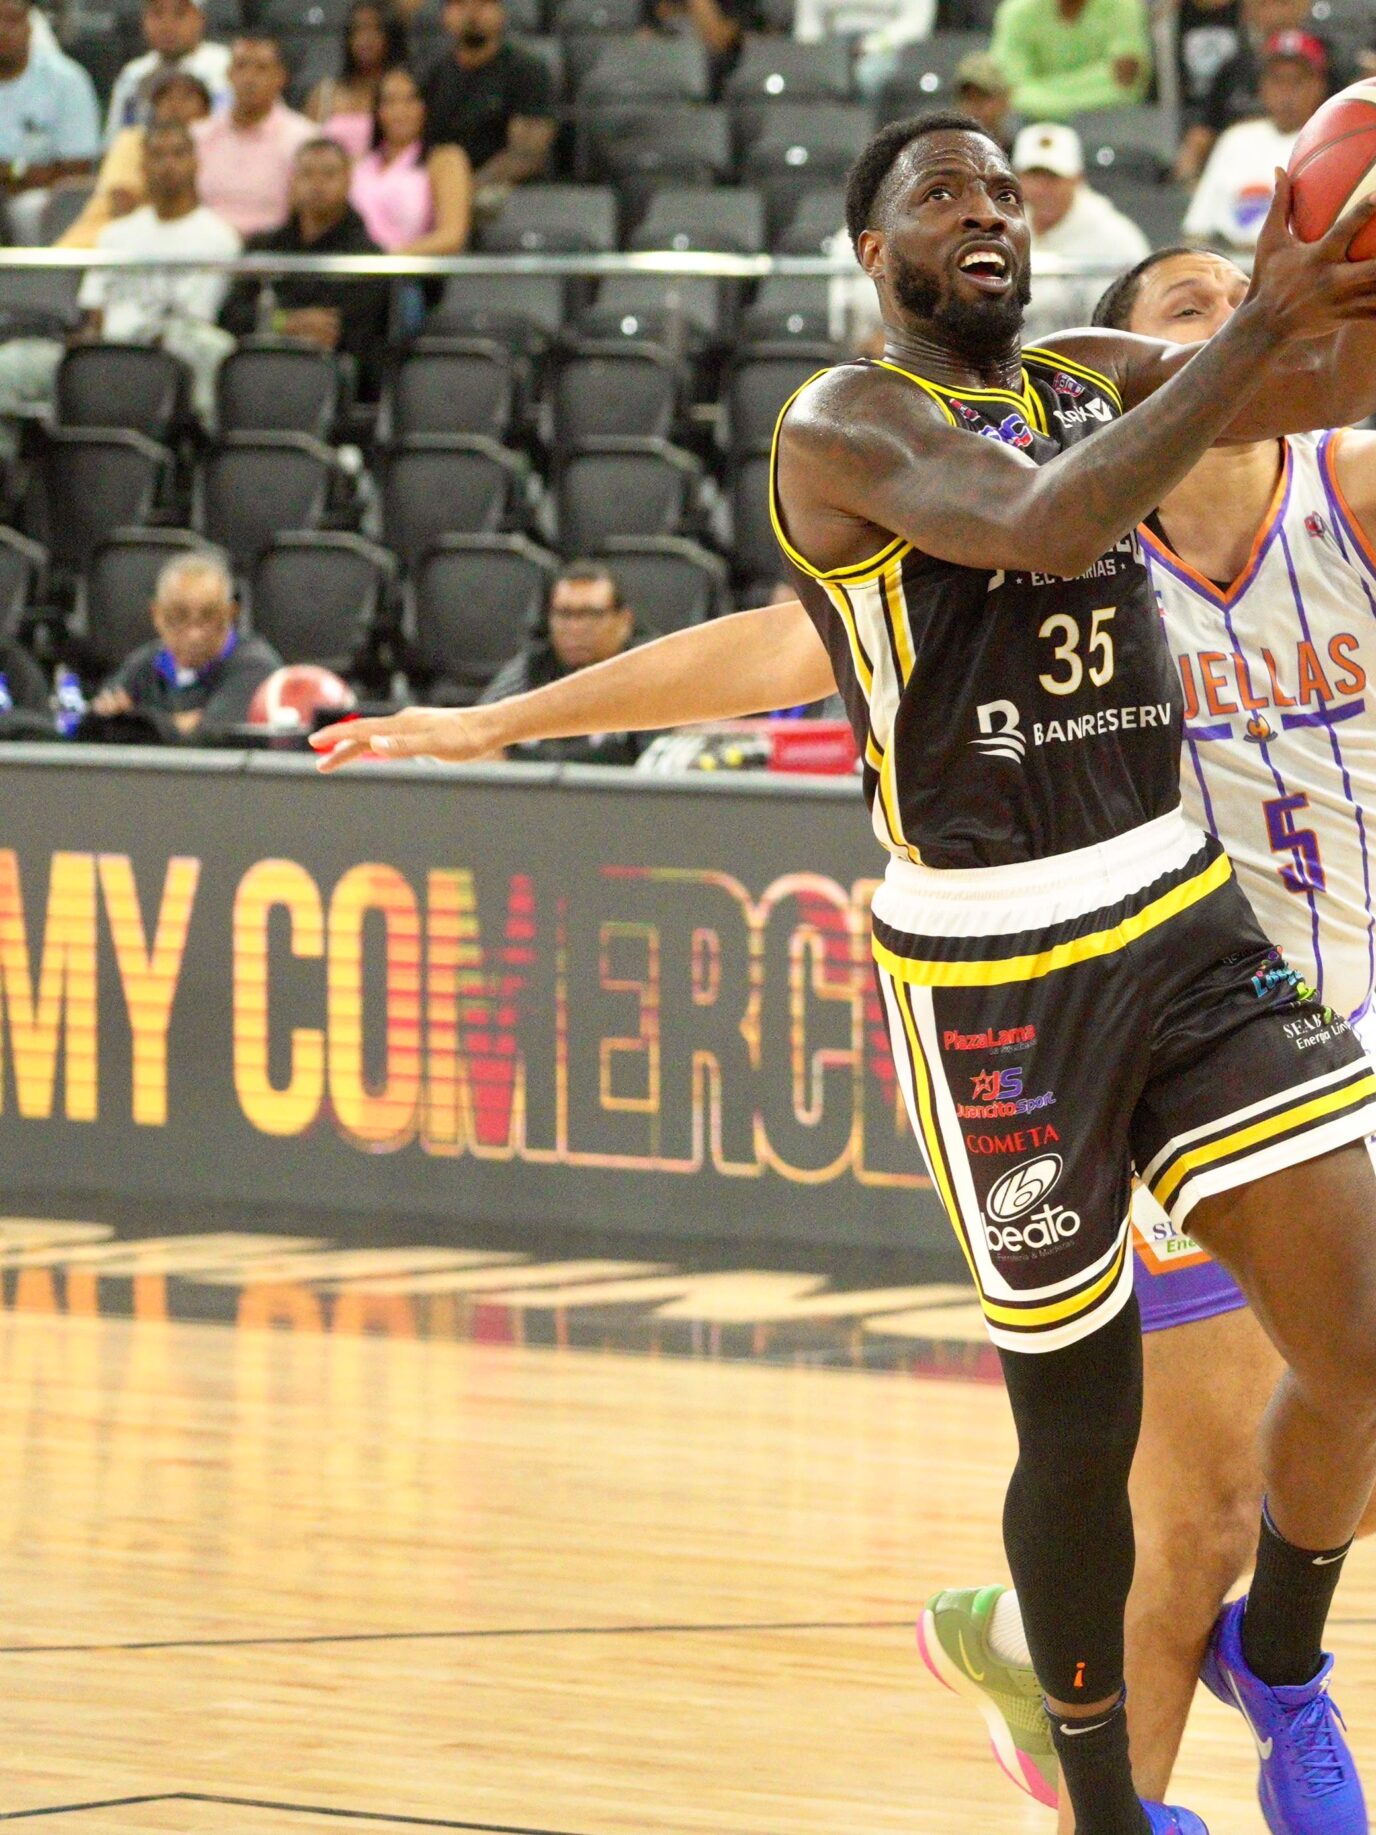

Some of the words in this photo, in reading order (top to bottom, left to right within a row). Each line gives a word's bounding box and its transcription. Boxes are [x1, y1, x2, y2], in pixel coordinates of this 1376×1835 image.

[1038, 607, 1117, 696] 35
[1262, 792, 1326, 893] 5
[232, 857, 930, 1188] COMERC
[943, 1024, 1037, 1051] PlazaLama
[965, 1123, 1060, 1155] COMETA
[980, 1203, 1081, 1252] beato
